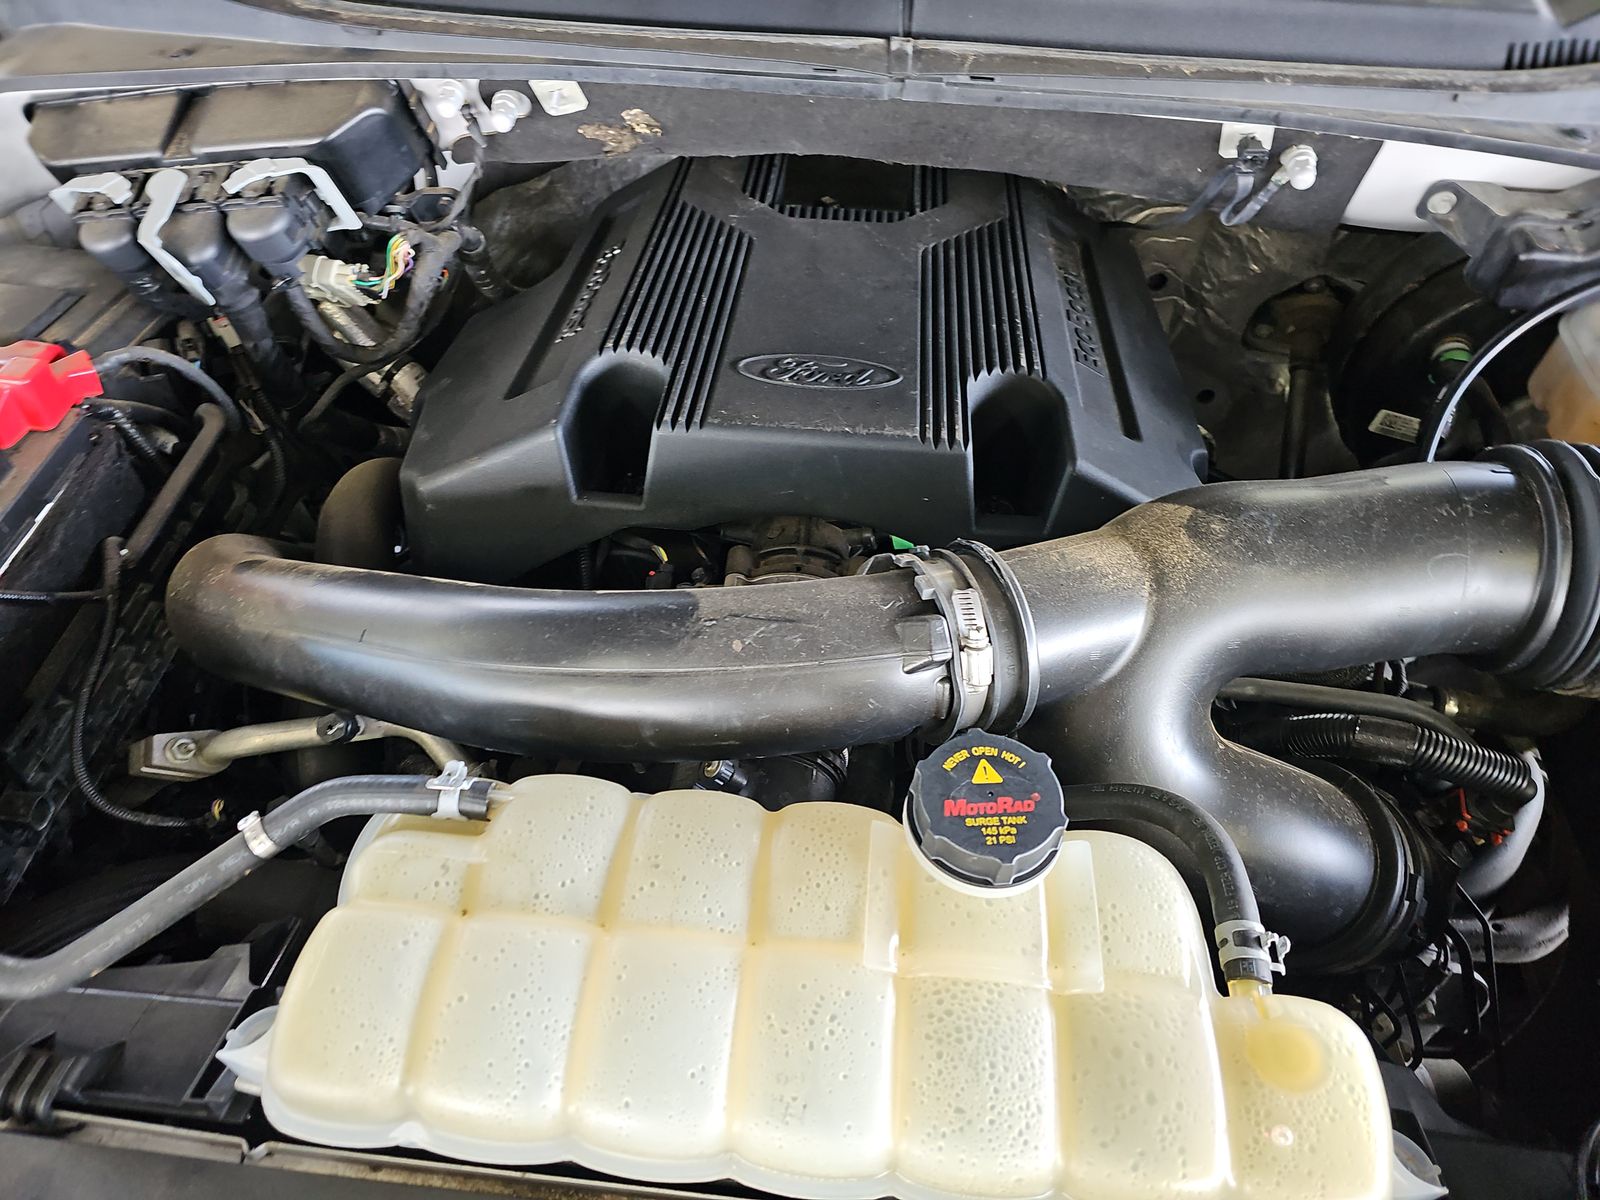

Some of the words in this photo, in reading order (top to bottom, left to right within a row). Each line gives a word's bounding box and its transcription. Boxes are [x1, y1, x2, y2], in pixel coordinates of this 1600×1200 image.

[763, 357, 875, 386] Ford
[943, 750, 970, 770] NEVER
[971, 746, 998, 757] OPEN
[1001, 751, 1021, 764] HOT
[965, 817, 1000, 827] SURGE
[1001, 816, 1028, 825] TANK
[981, 827, 998, 835] 145
[999, 826, 1017, 835] kPa
[985, 836, 998, 845] 21
[999, 835, 1016, 845] PSI
